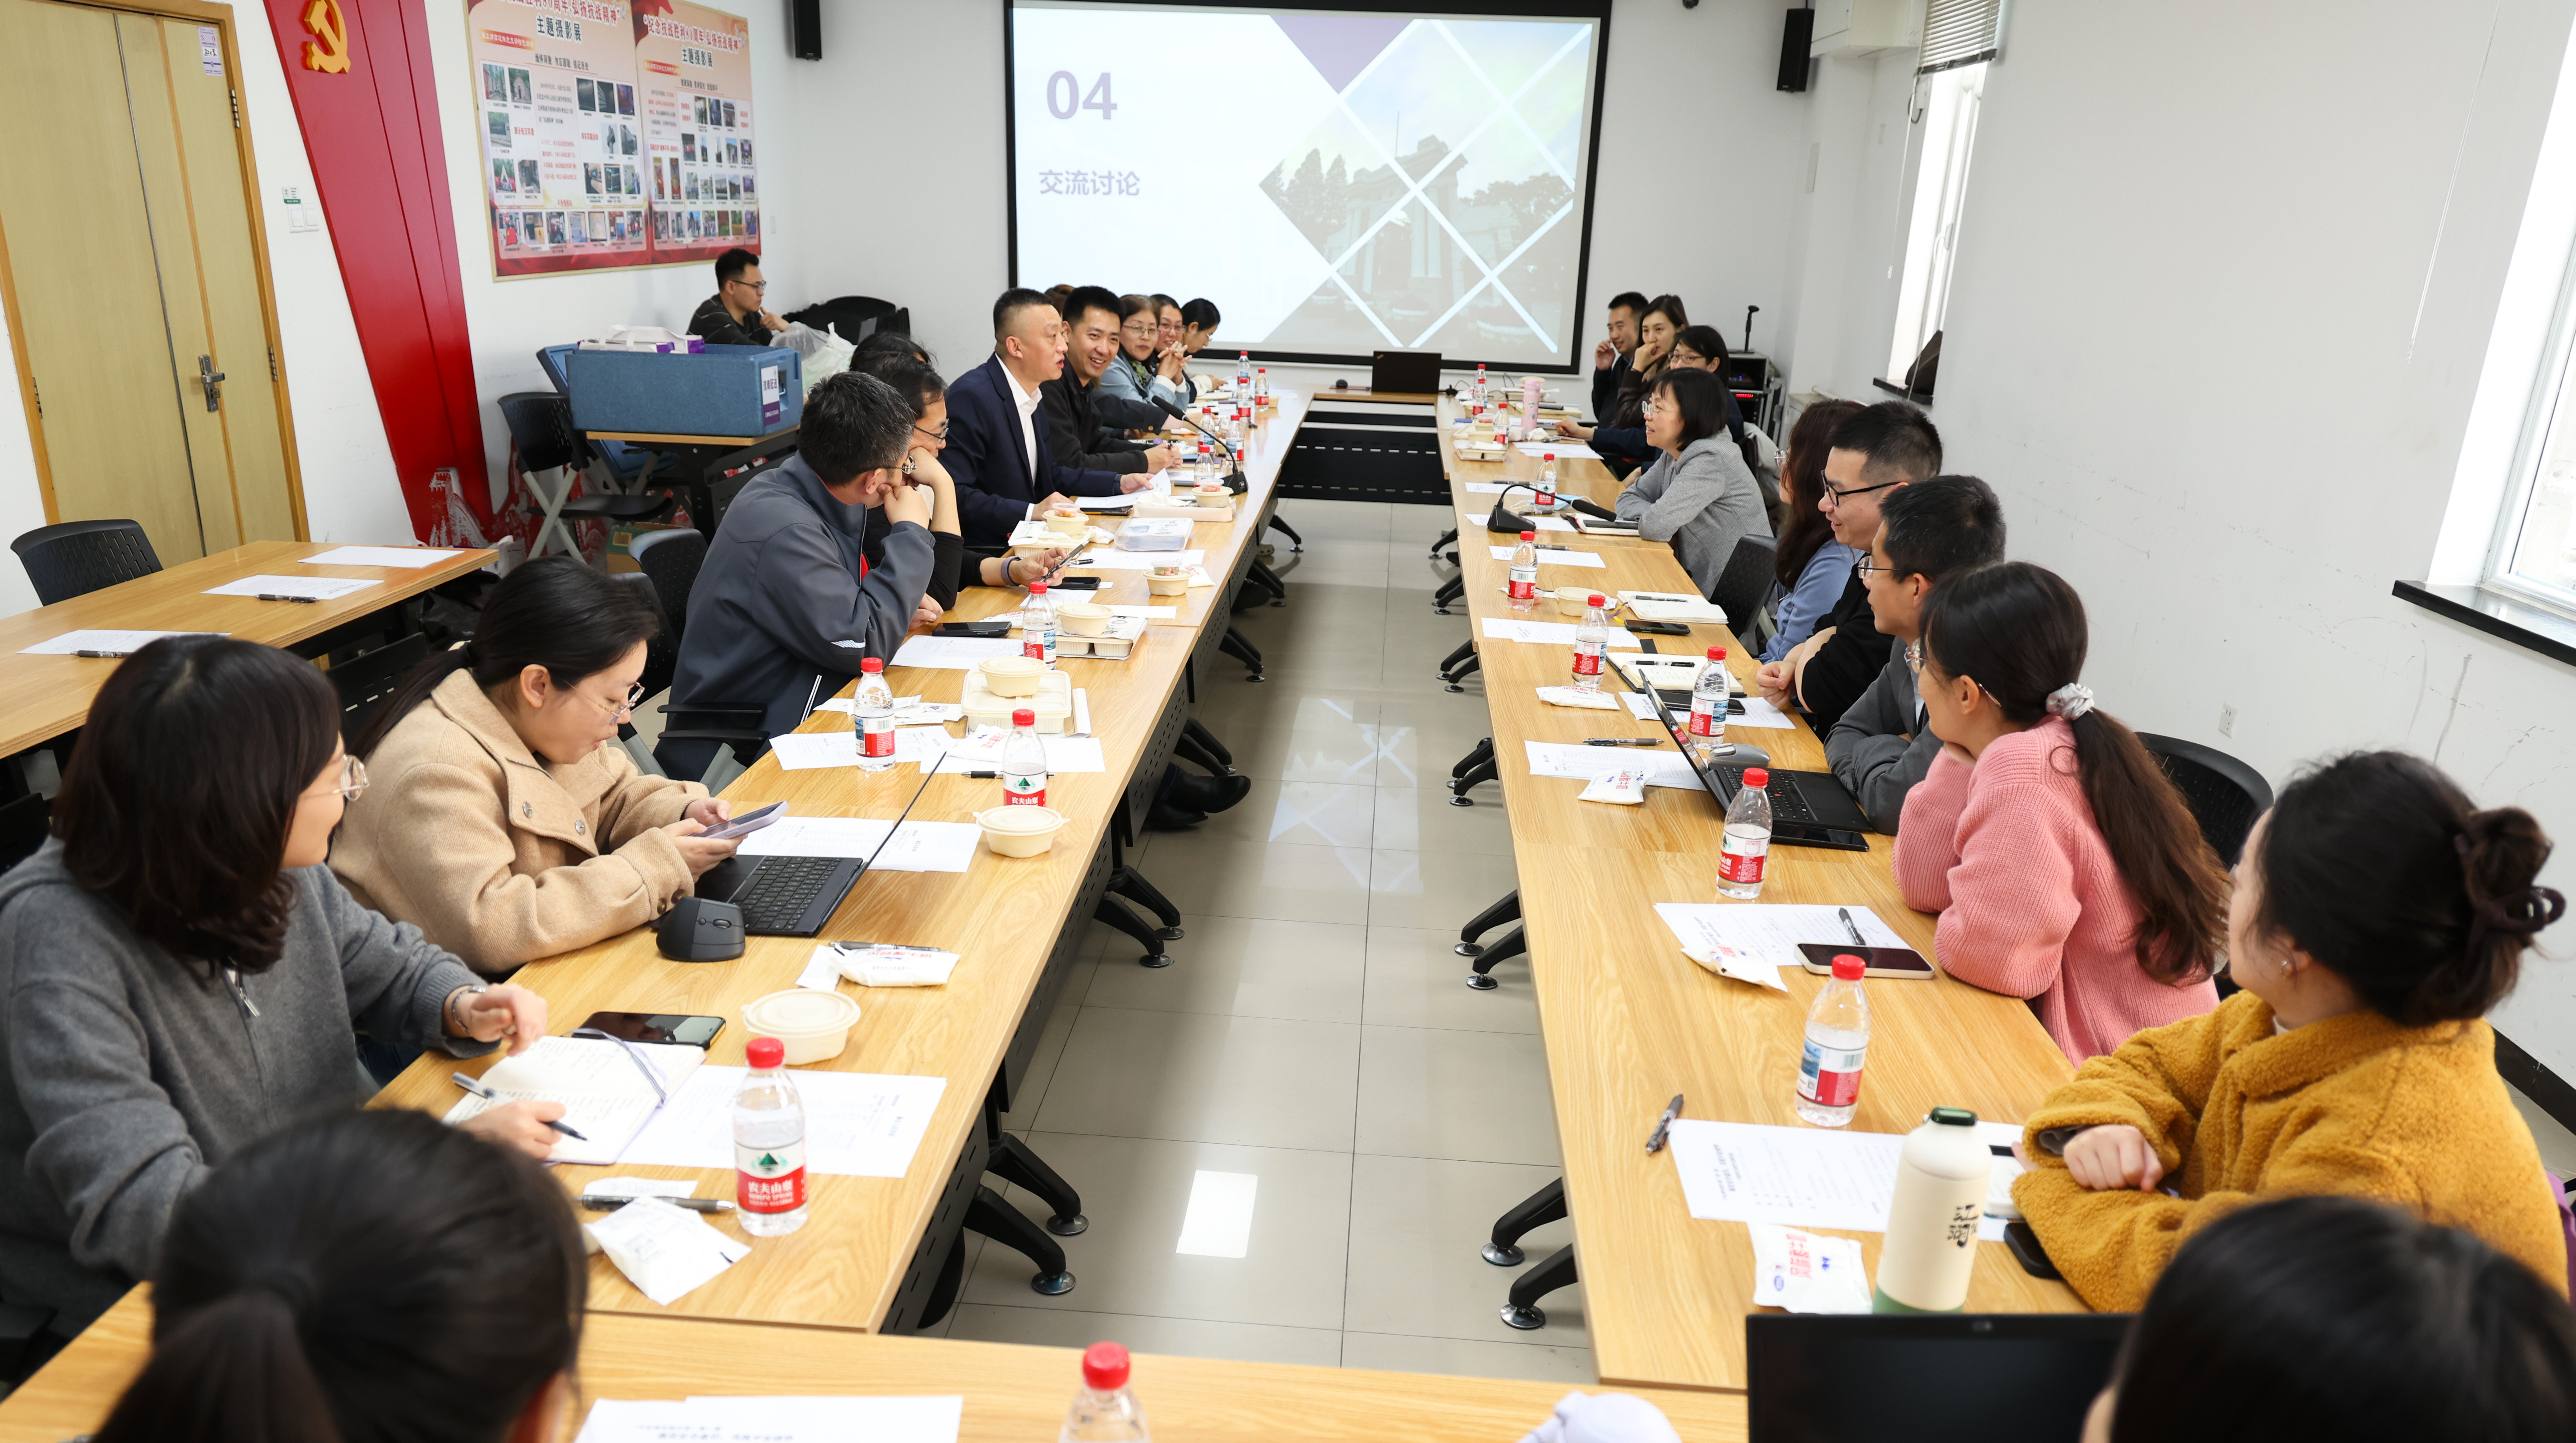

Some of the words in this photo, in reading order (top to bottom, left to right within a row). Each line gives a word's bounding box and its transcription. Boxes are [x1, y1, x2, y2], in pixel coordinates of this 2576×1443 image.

[537, 16, 581, 41] 主题摄影展
[682, 47, 713, 67] 主题摄影展
[1046, 71, 1117, 120] 04
[1039, 169, 1141, 196] 交流讨论
[1012, 796, 1039, 805] 农夫山泉
[748, 1178, 793, 1194] 农夫山泉
